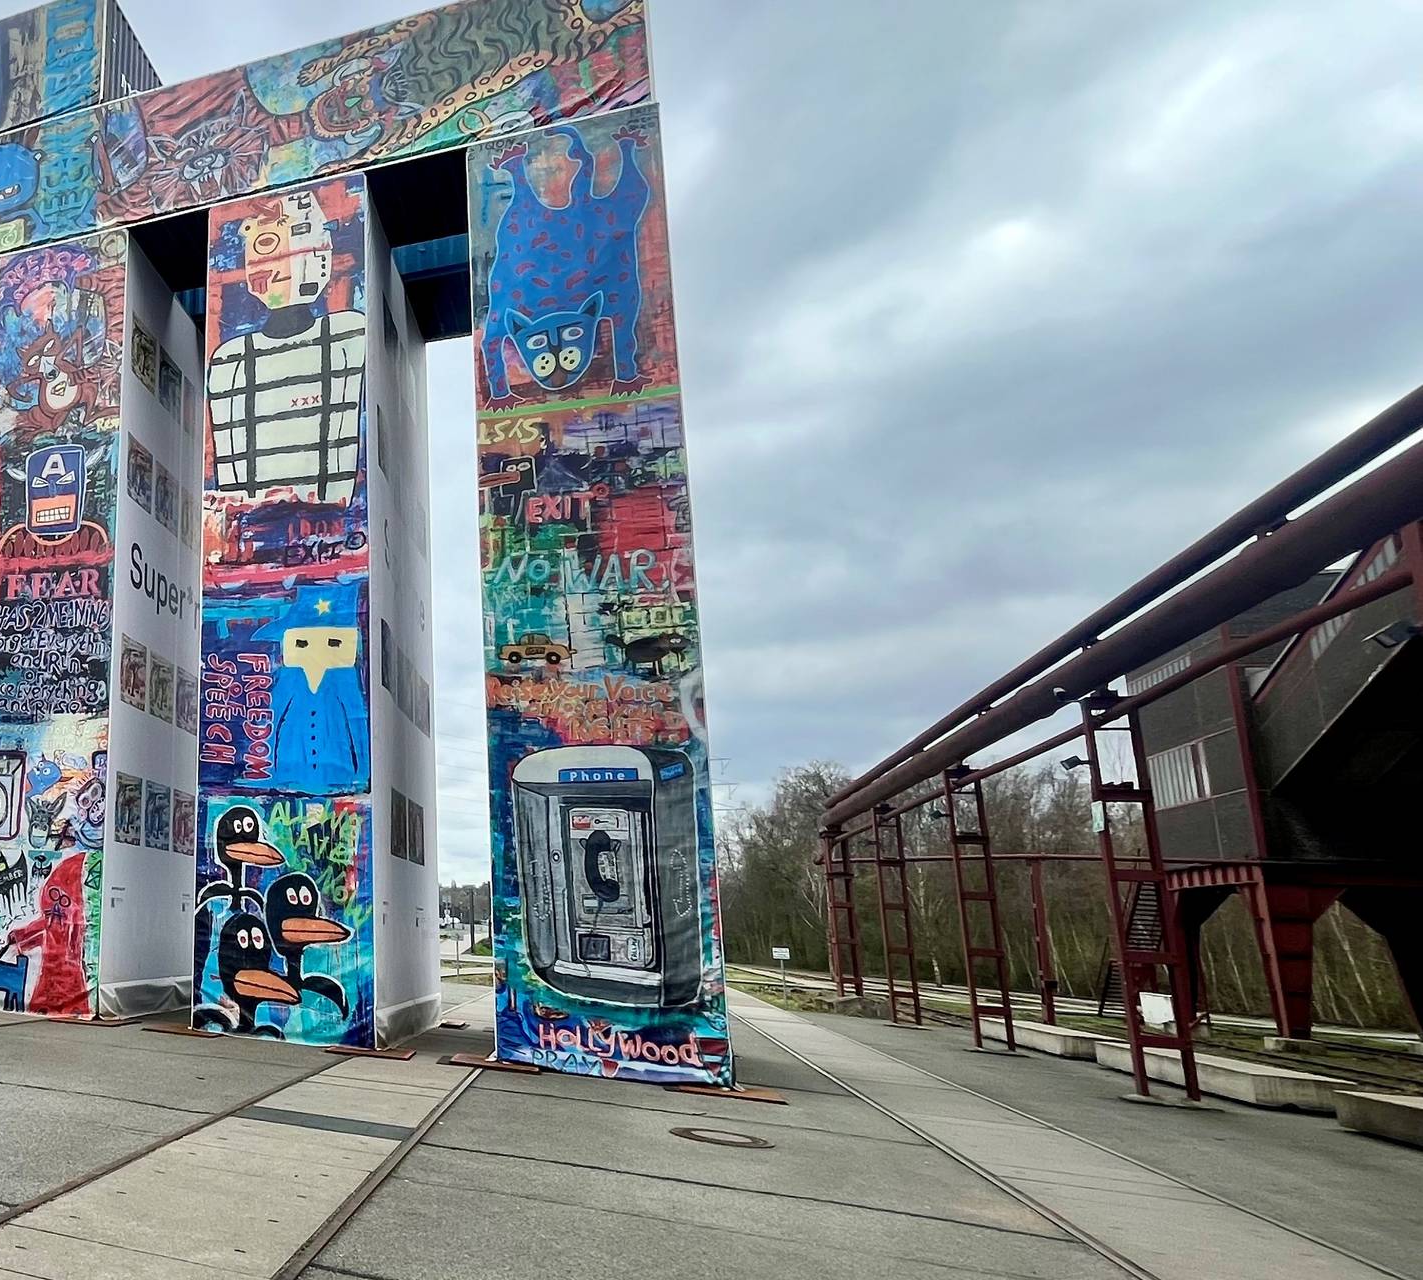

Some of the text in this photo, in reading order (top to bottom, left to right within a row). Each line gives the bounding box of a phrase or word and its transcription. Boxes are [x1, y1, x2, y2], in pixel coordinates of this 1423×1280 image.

[529, 491, 593, 523] EXIT
[6, 568, 102, 600] FEAR
[31, 601, 47, 629] 2
[17, 680, 99, 705] Everything
[199, 653, 237, 765] SPEECH
[237, 653, 274, 781] FREEDOM
[569, 770, 626, 782] Phone
